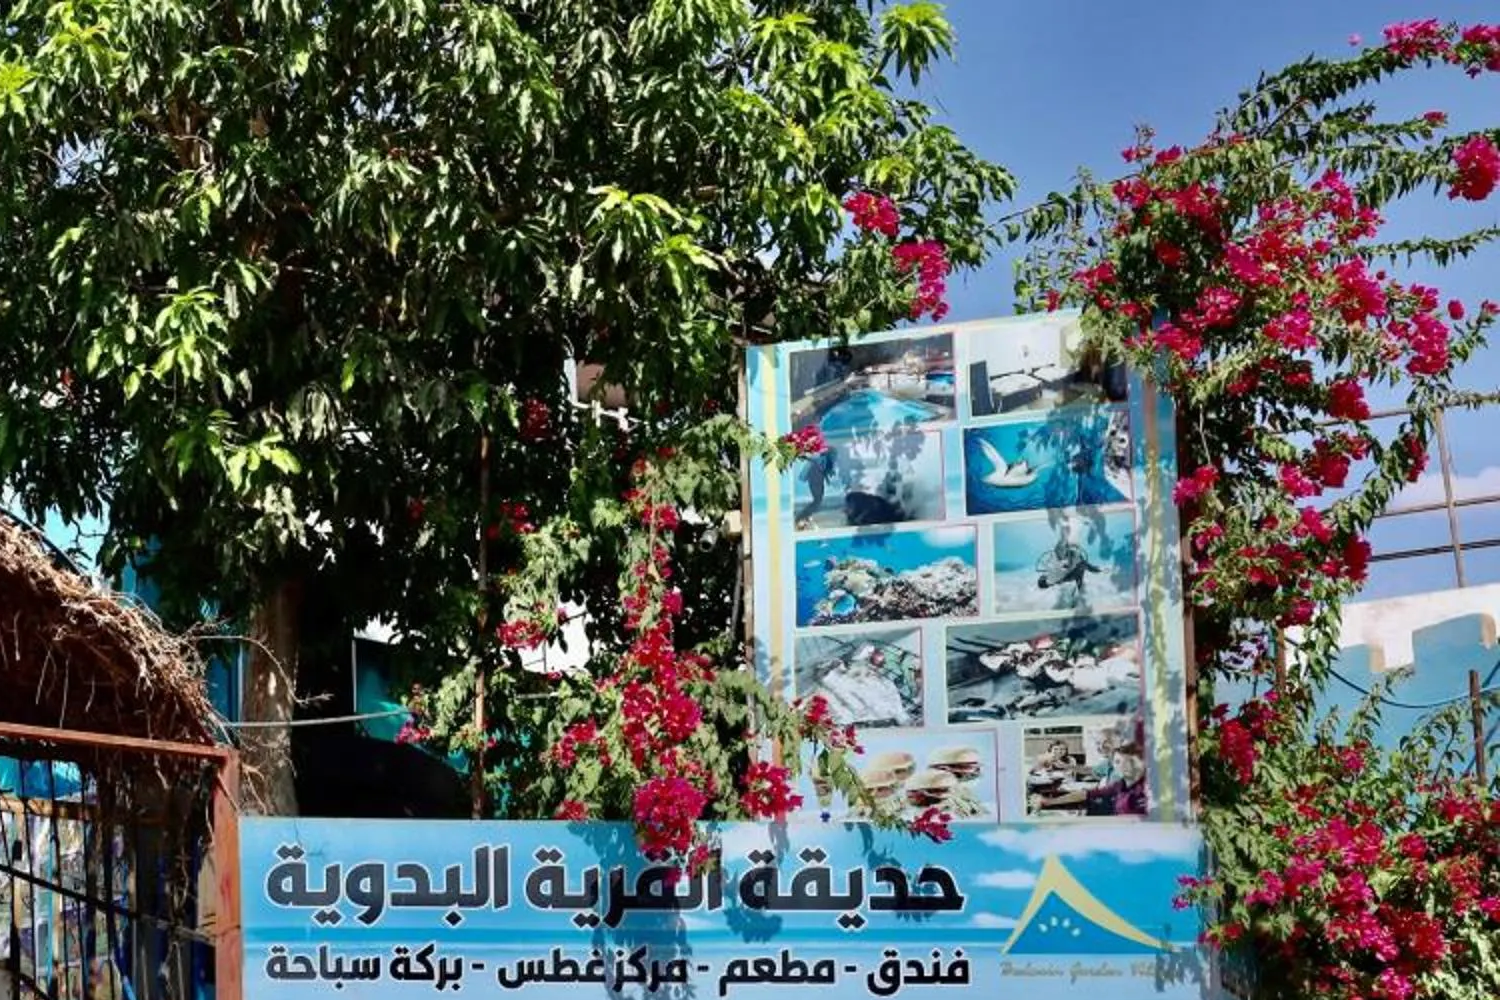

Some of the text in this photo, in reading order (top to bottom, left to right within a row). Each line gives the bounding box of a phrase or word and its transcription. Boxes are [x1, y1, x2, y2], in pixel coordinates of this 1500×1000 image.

[268, 846, 508, 926] البدوية
[739, 848, 964, 929] حديقة
[267, 946, 381, 989] سباحة
[389, 944, 463, 991] بركة
[719, 949, 835, 997] مطعم
[867, 949, 969, 997] فندق
